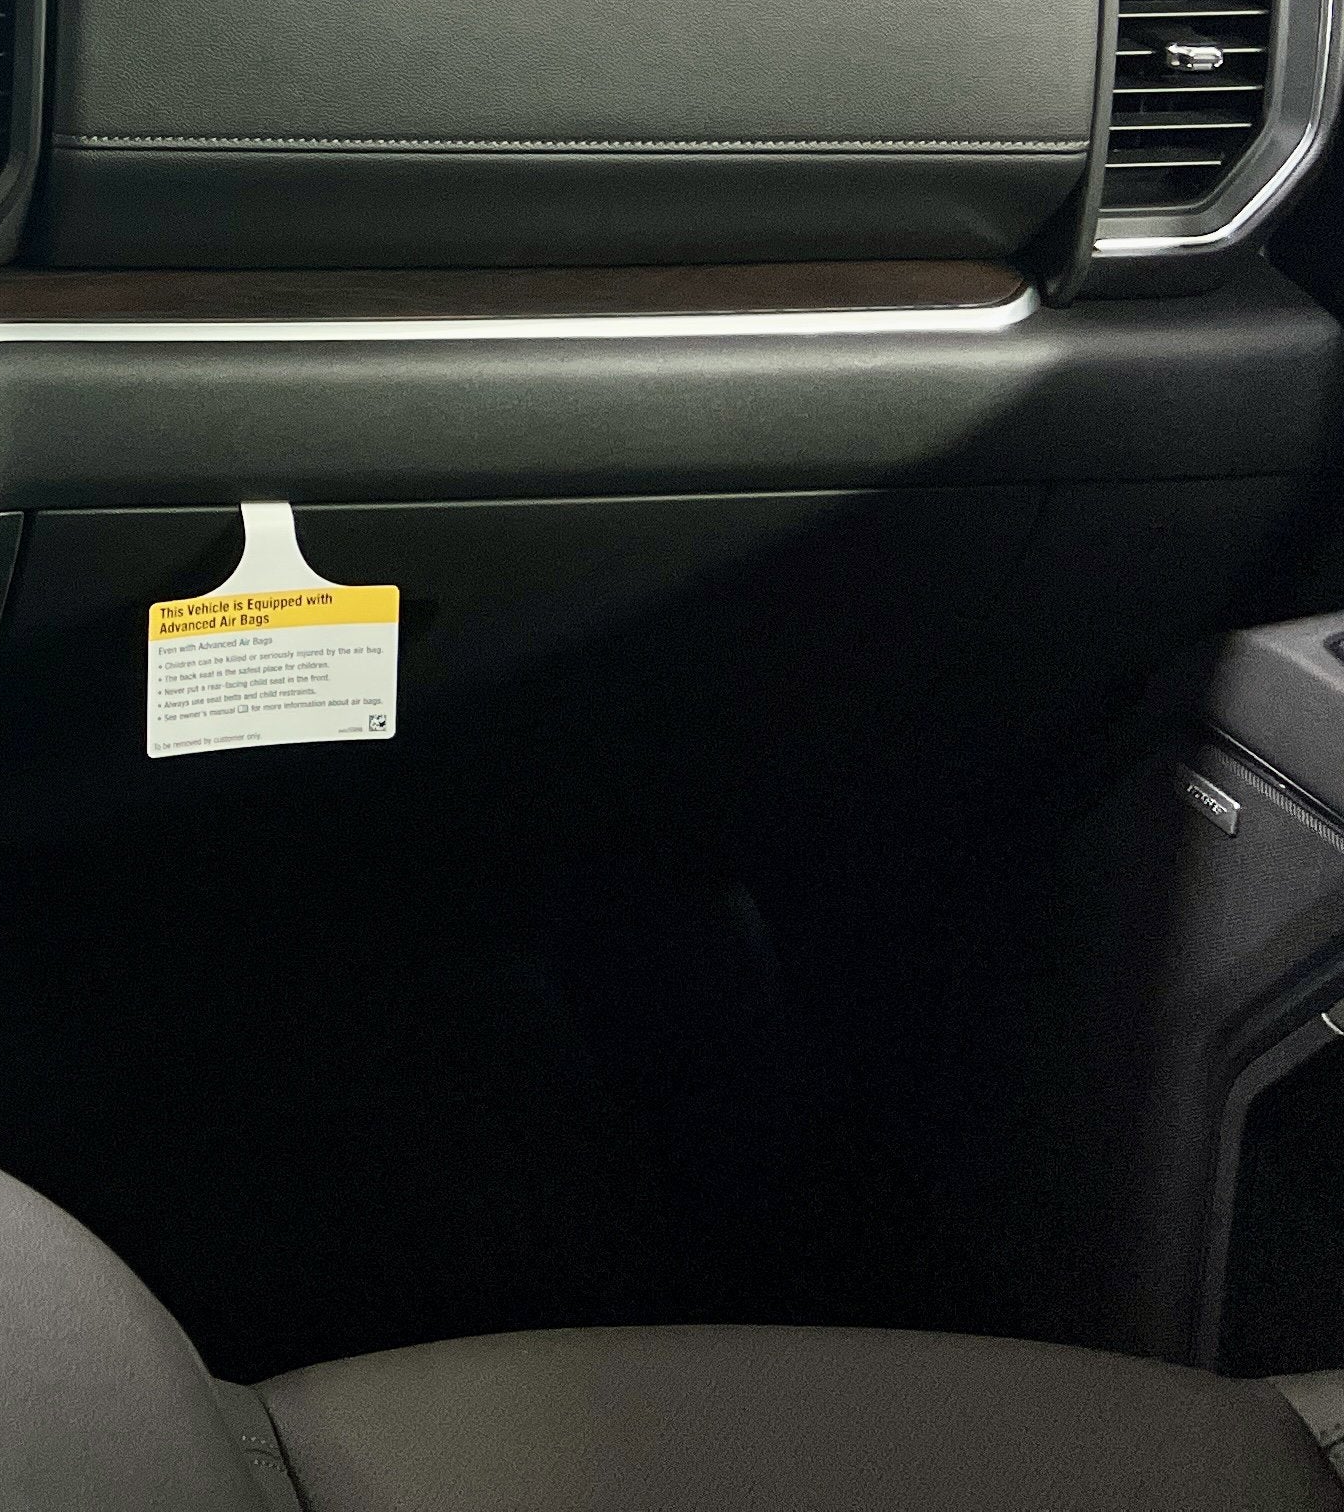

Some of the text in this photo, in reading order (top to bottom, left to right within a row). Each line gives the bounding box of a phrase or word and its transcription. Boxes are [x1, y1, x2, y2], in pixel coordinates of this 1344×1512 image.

[159, 593, 333, 620] This Vehicle is Equipped with
[159, 613, 270, 634] Advanced Air Bags
[158, 637, 273, 655] Even with Advanced Air Bags
[164, 660, 196, 670] Children
[198, 658, 212, 666] can
[214, 656, 223, 664] be
[226, 654, 246, 662] killed
[260, 650, 294, 660] seriously
[296, 648, 324, 658] injured
[326, 648, 336, 656] by
[180, 673, 196, 681] back
[224, 668, 236, 676] the
[238, 666, 260, 674] safest
[262, 664, 282, 674] place
[164, 688, 185, 696] Never
[187, 686, 199, 694] put
[250, 678, 268, 686] child
[164, 700, 190, 709] Always
[192, 698, 204, 706] use
[206, 696, 222, 704] seat
[224, 694, 242, 702] belts
[244, 692, 258, 700] and
[260, 690, 277, 698] child
[164, 713, 177, 722] See
[210, 708, 236, 716] manual
[251, 704, 261, 712] for
[284, 700, 326, 709] information
[328, 698, 349, 706] about
[351, 698, 360, 706] air
[172, 738, 202, 748] removed
[213, 734, 245, 742] customer
